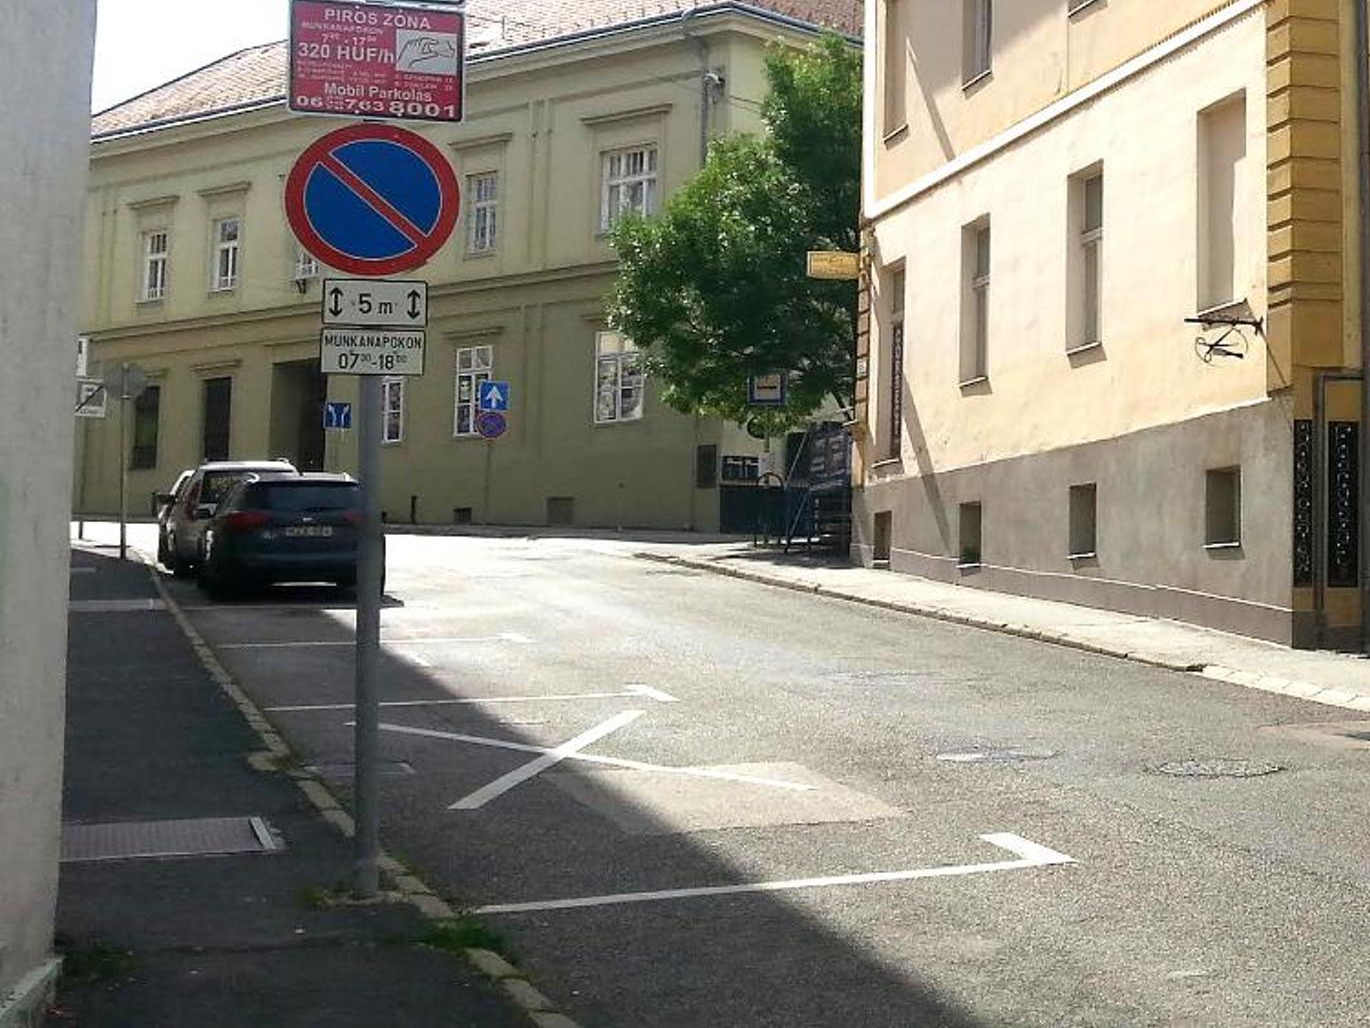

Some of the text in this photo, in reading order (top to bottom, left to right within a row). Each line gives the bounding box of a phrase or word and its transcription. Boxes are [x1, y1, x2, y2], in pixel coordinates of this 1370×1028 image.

[324, 8, 431, 29] PIROS ZÓNA
[298, 42, 394, 64] 320 HUF/h
[324, 82, 364, 97] Mobil
[358, 293, 393, 314] 5 m
[325, 335, 422, 349] MUNKANAPOKON
